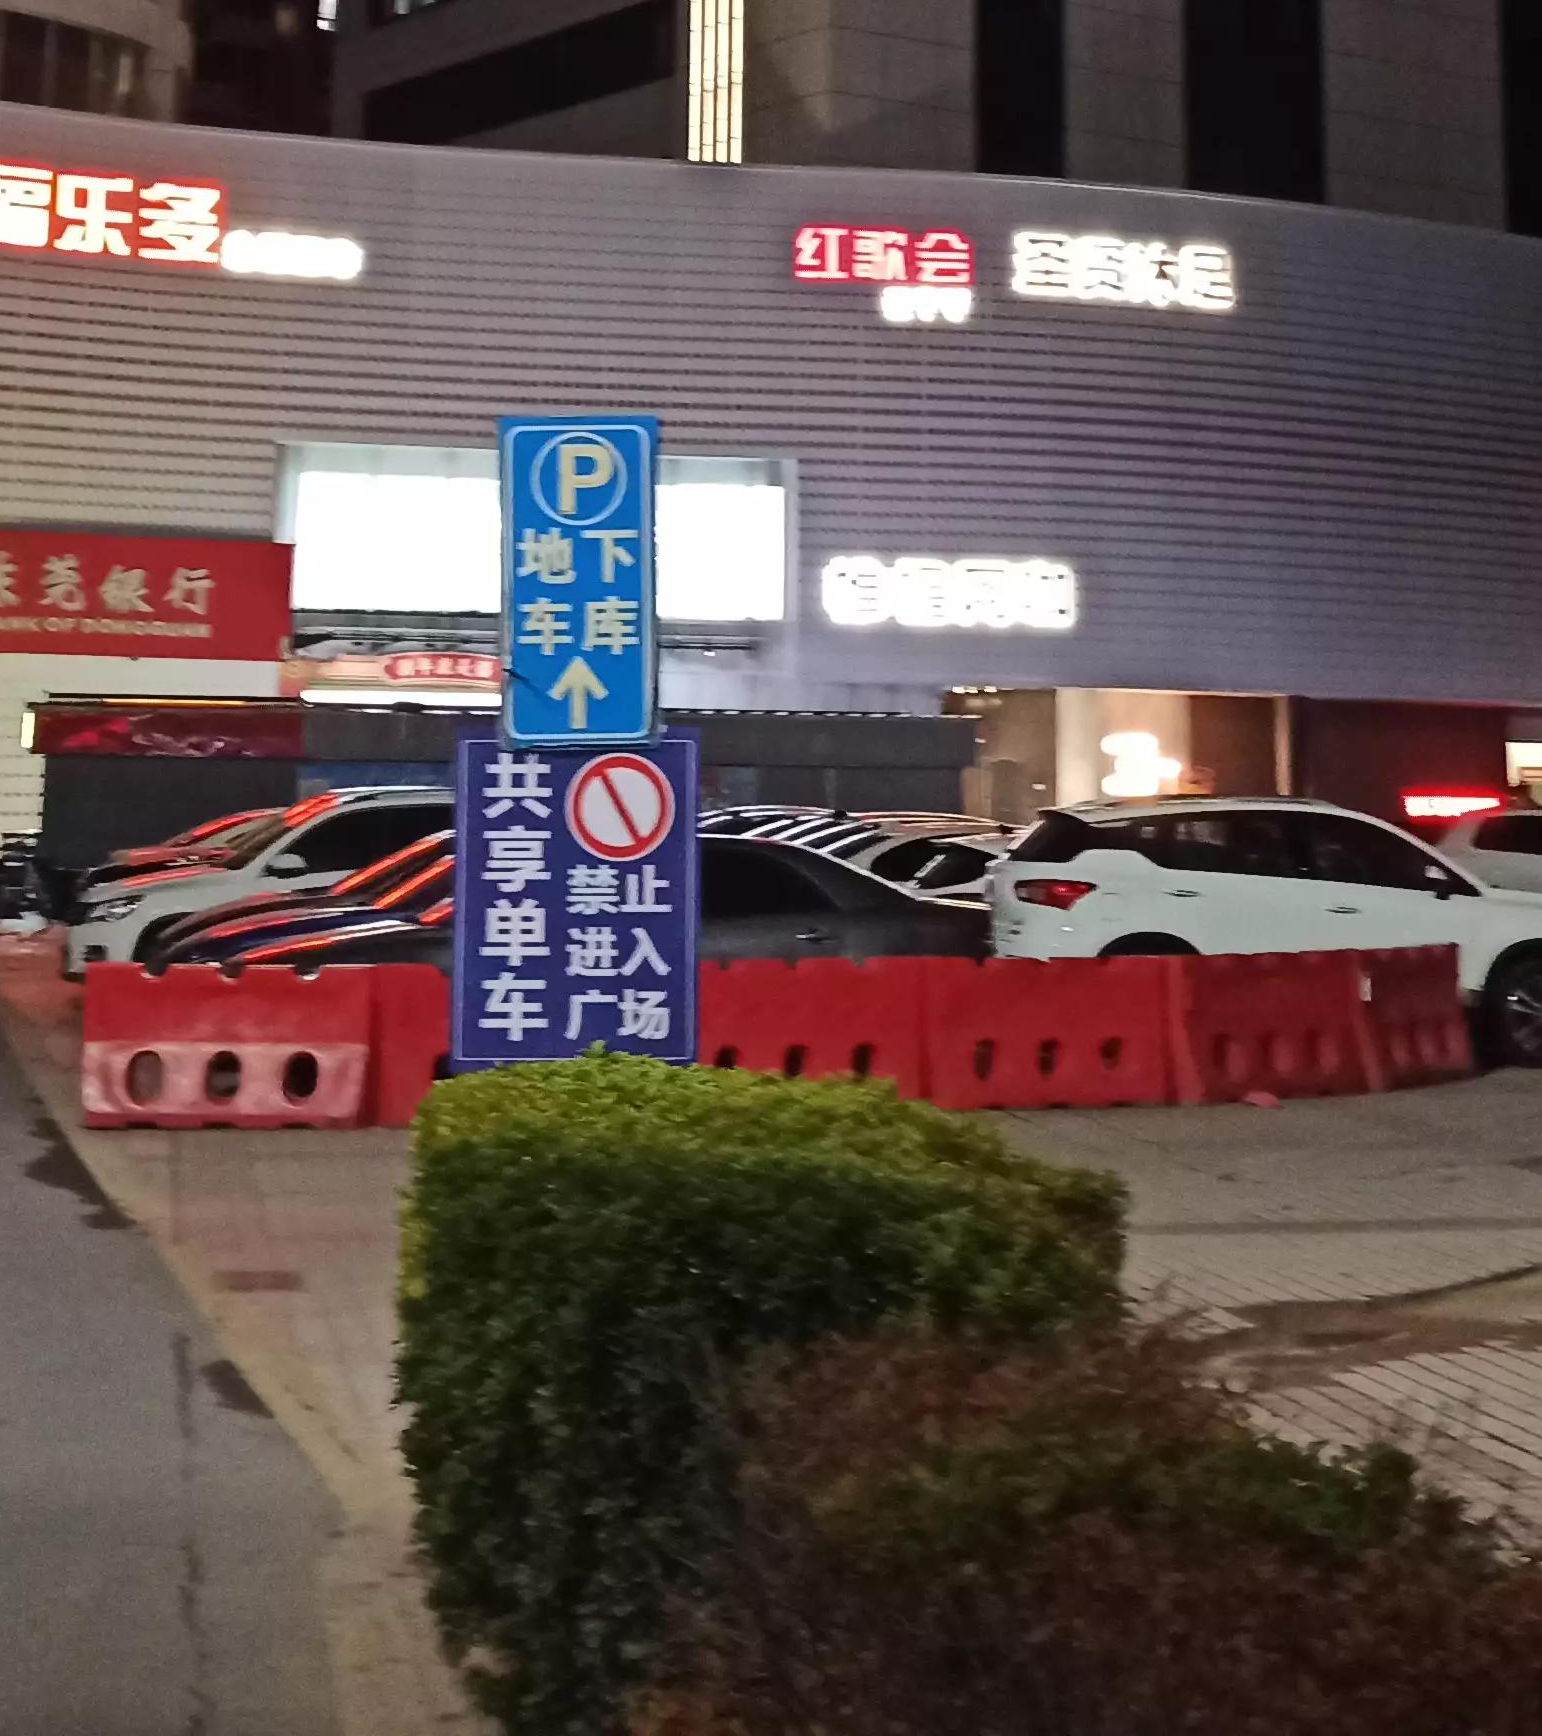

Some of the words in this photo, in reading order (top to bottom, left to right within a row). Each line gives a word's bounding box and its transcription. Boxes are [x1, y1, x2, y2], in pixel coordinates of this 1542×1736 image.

[793, 226, 972, 283] 红歌会
[559, 443, 613, 513] P
[517, 527, 639, 585] 地下
[517, 595, 639, 656] 车库
[478, 752, 553, 1042] 共享单车
[565, 864, 672, 916] 禁止
[564, 926, 672, 978] 进入
[564, 988, 670, 1041] 广场
